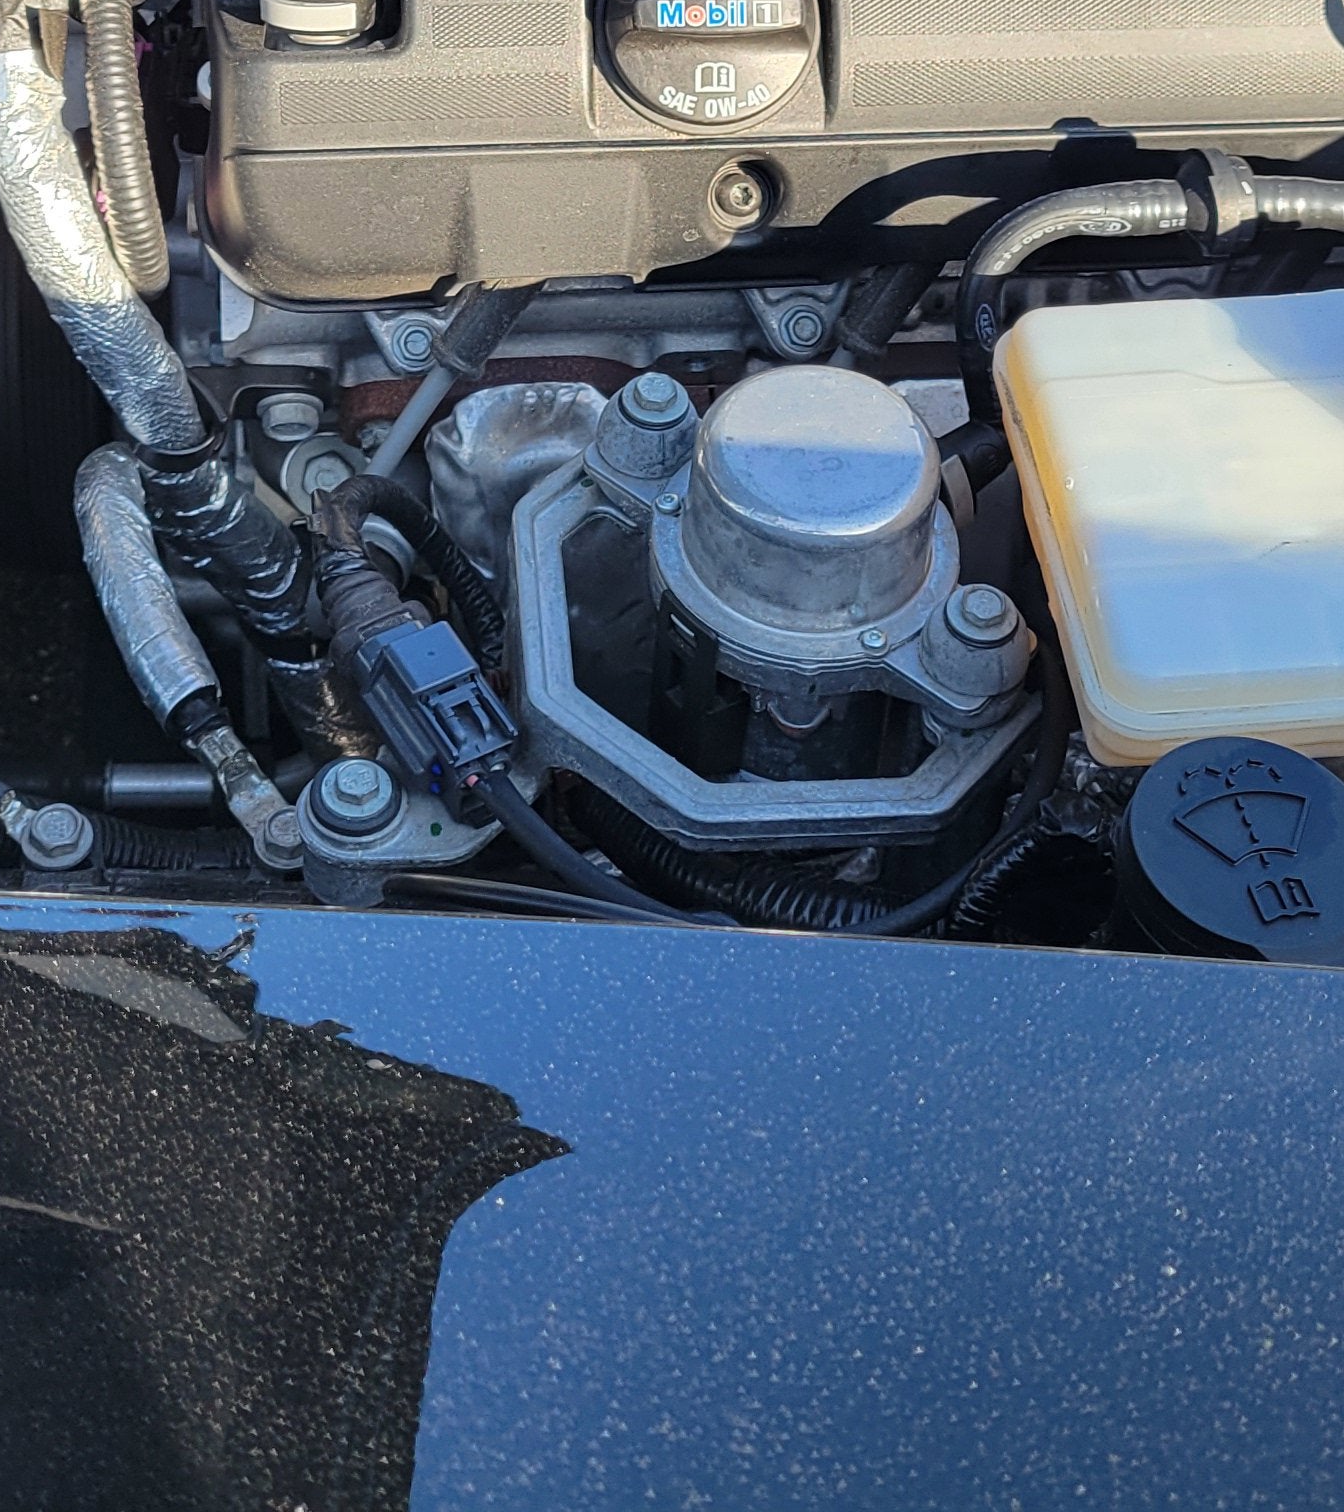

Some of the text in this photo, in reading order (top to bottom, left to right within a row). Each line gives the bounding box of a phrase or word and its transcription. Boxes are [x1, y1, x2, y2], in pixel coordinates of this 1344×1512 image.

[656, 0, 747, 27] Mobil
[658, 83, 771, 118] SAE 0W-40
